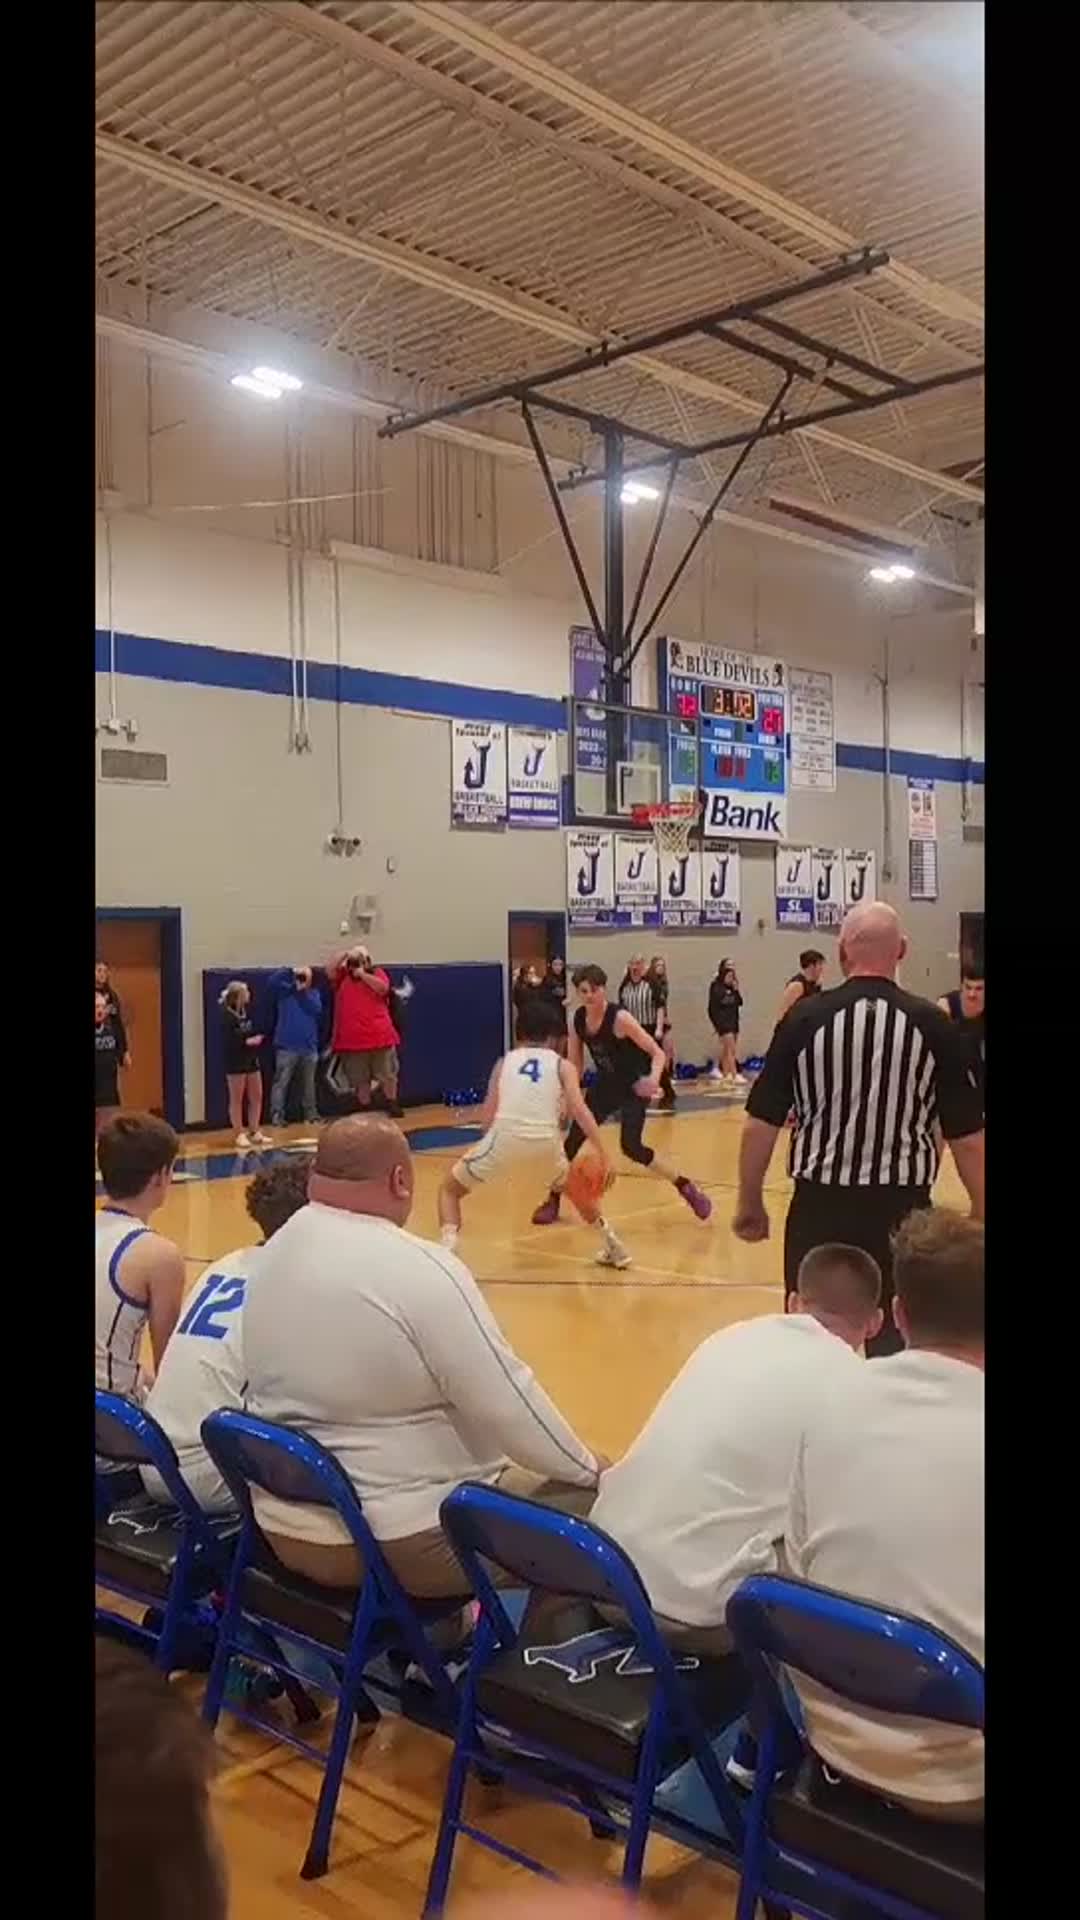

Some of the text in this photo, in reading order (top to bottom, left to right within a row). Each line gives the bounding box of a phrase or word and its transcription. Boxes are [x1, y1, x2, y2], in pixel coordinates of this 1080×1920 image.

[686, 655, 769, 685] BLUE DEVILS
[711, 795, 780, 833] Bank
[519, 1059, 541, 1082] 4
[177, 1273, 247, 1339] 12
